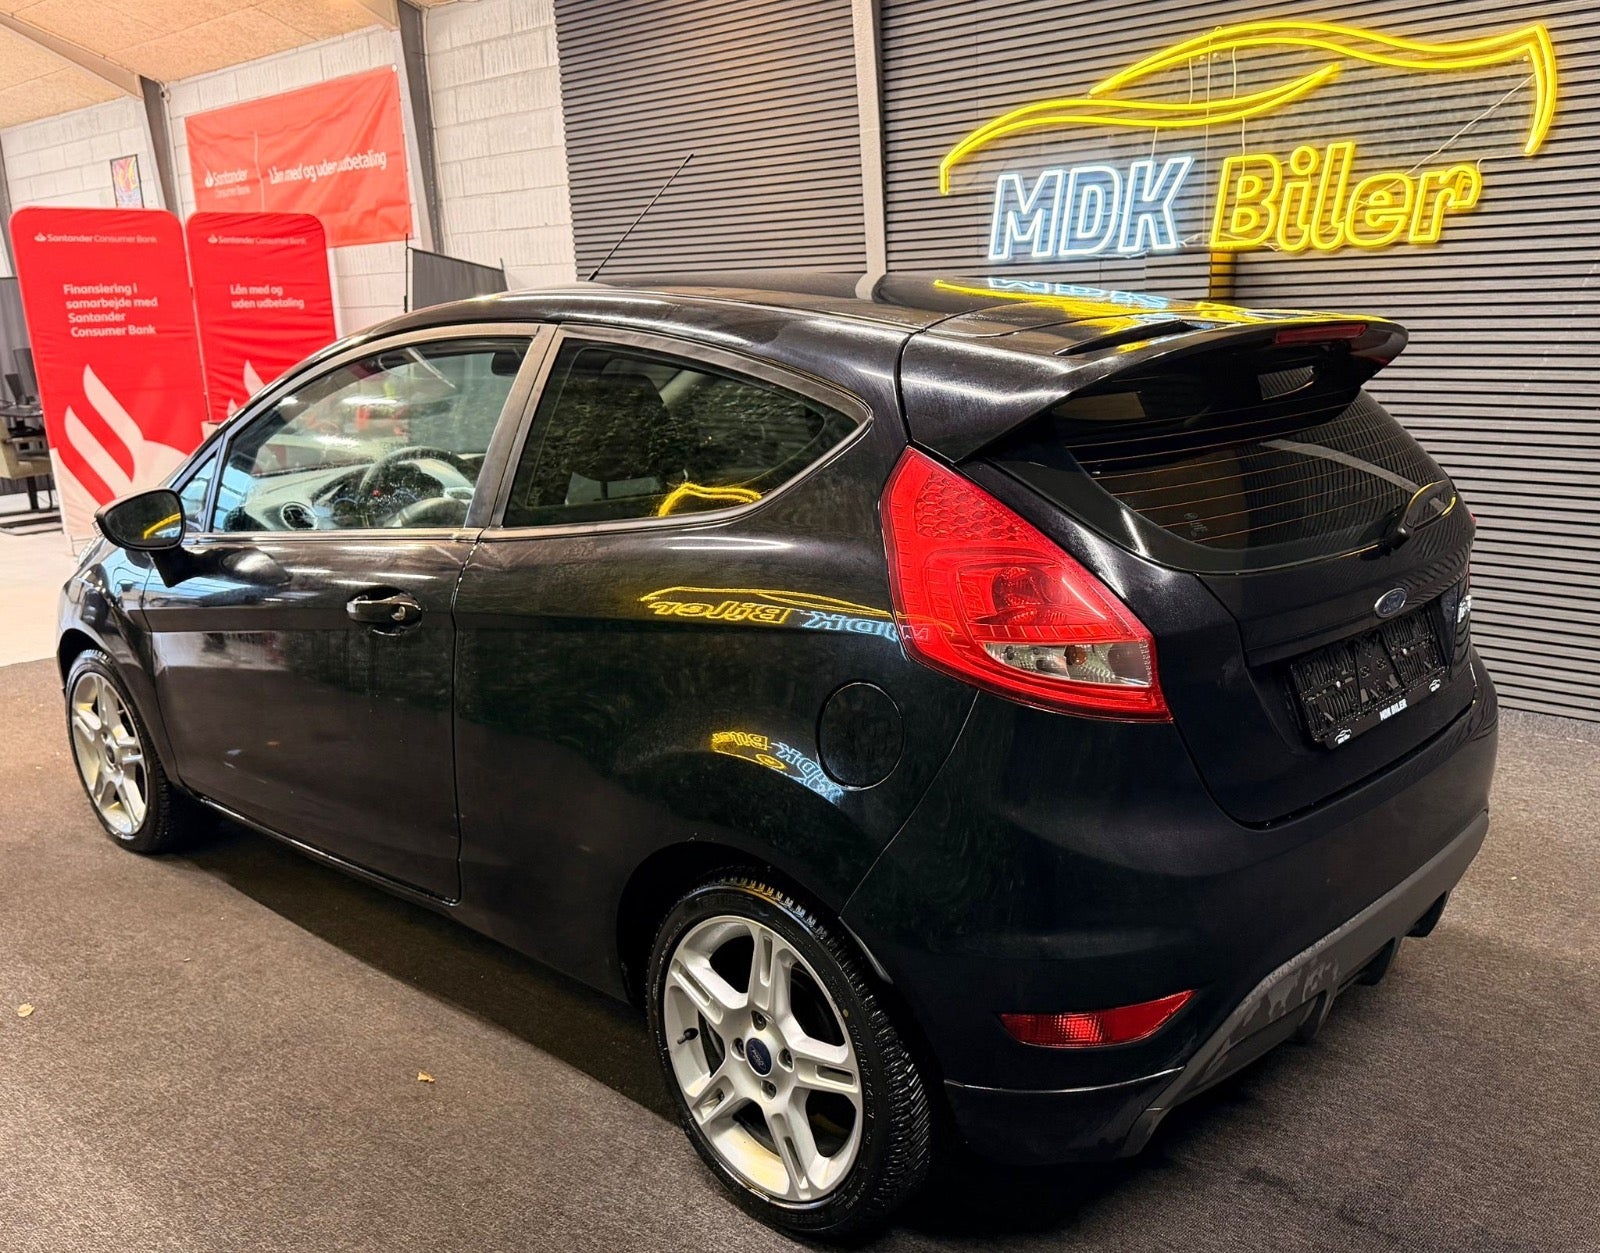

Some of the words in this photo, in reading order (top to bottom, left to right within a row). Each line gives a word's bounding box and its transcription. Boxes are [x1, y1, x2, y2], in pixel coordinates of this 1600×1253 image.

[303, 164, 317, 183] og
[987, 155, 1194, 261] MDK
[1207, 140, 1482, 252] Biler
[47, 233, 93, 243] Santander
[94, 234, 136, 244] Consumer
[137, 234, 158, 244] Bank
[63, 283, 132, 296] Finansiering
[230, 284, 248, 296] Lån
[249, 284, 270, 296] med
[271, 286, 284, 297] og
[65, 297, 132, 311] samarbejde
[134, 297, 159, 308] med
[231, 298, 256, 310] uden
[256, 297, 305, 311] udbetaling
[68, 311, 126, 324] Santander
[71, 326, 127, 338] Consumer
[128, 324, 157, 336] Bank
